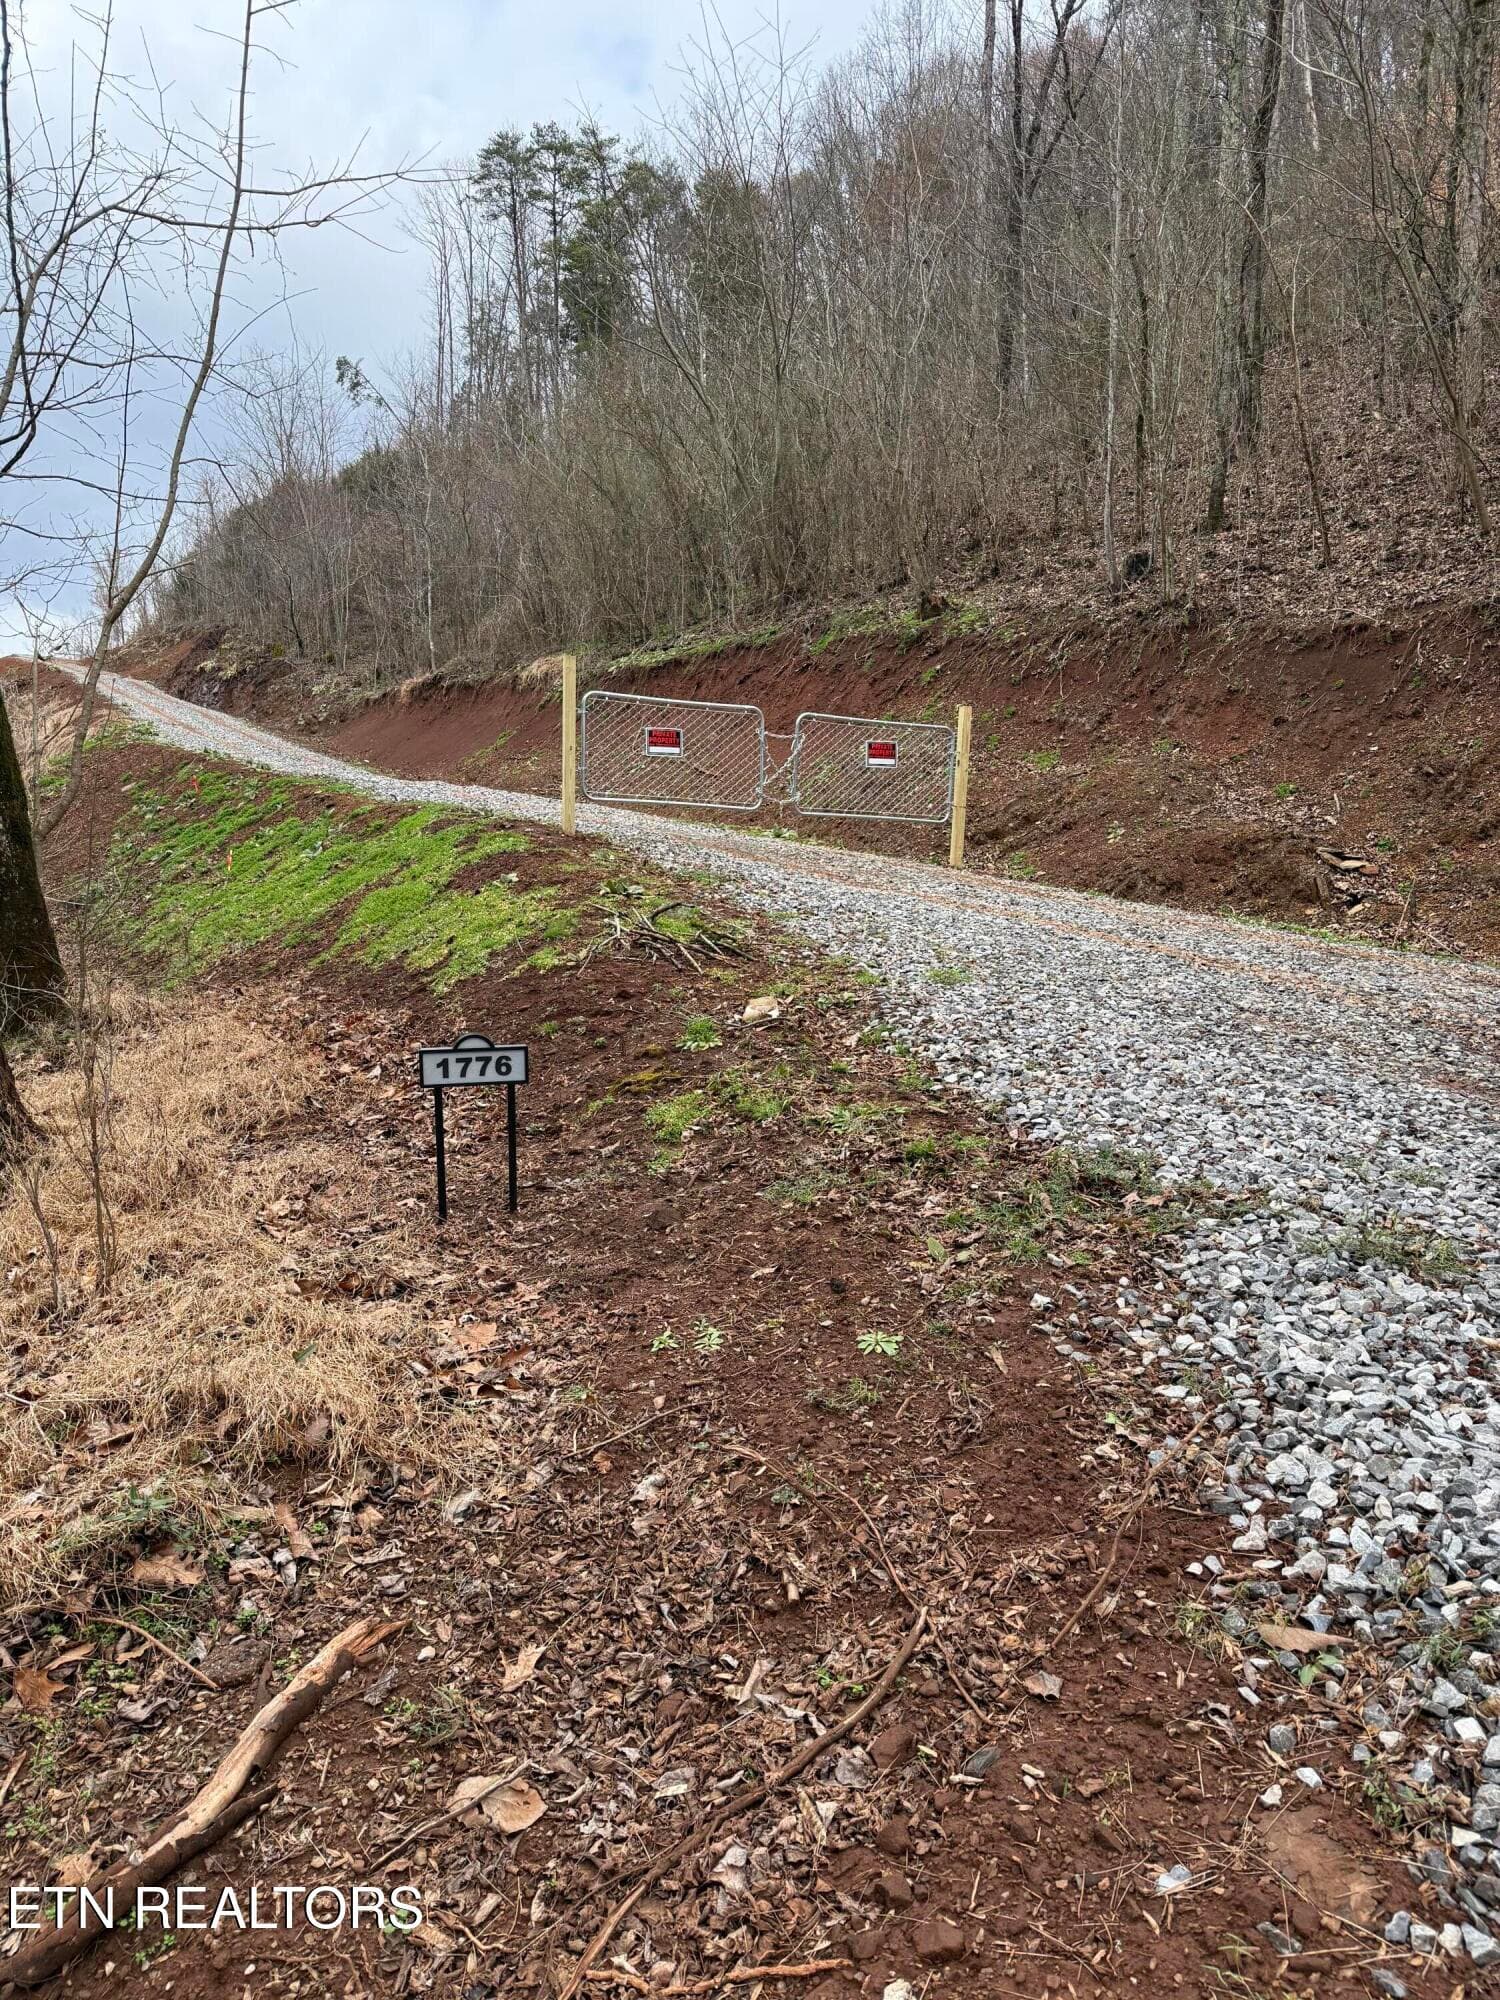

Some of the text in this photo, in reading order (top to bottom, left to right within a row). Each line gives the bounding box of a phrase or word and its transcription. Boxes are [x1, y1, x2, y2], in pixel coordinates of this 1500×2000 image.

[652, 729, 677, 737] PRIVATE
[649, 737, 680, 745] PROPERTY
[436, 1055, 512, 1079] 1776
